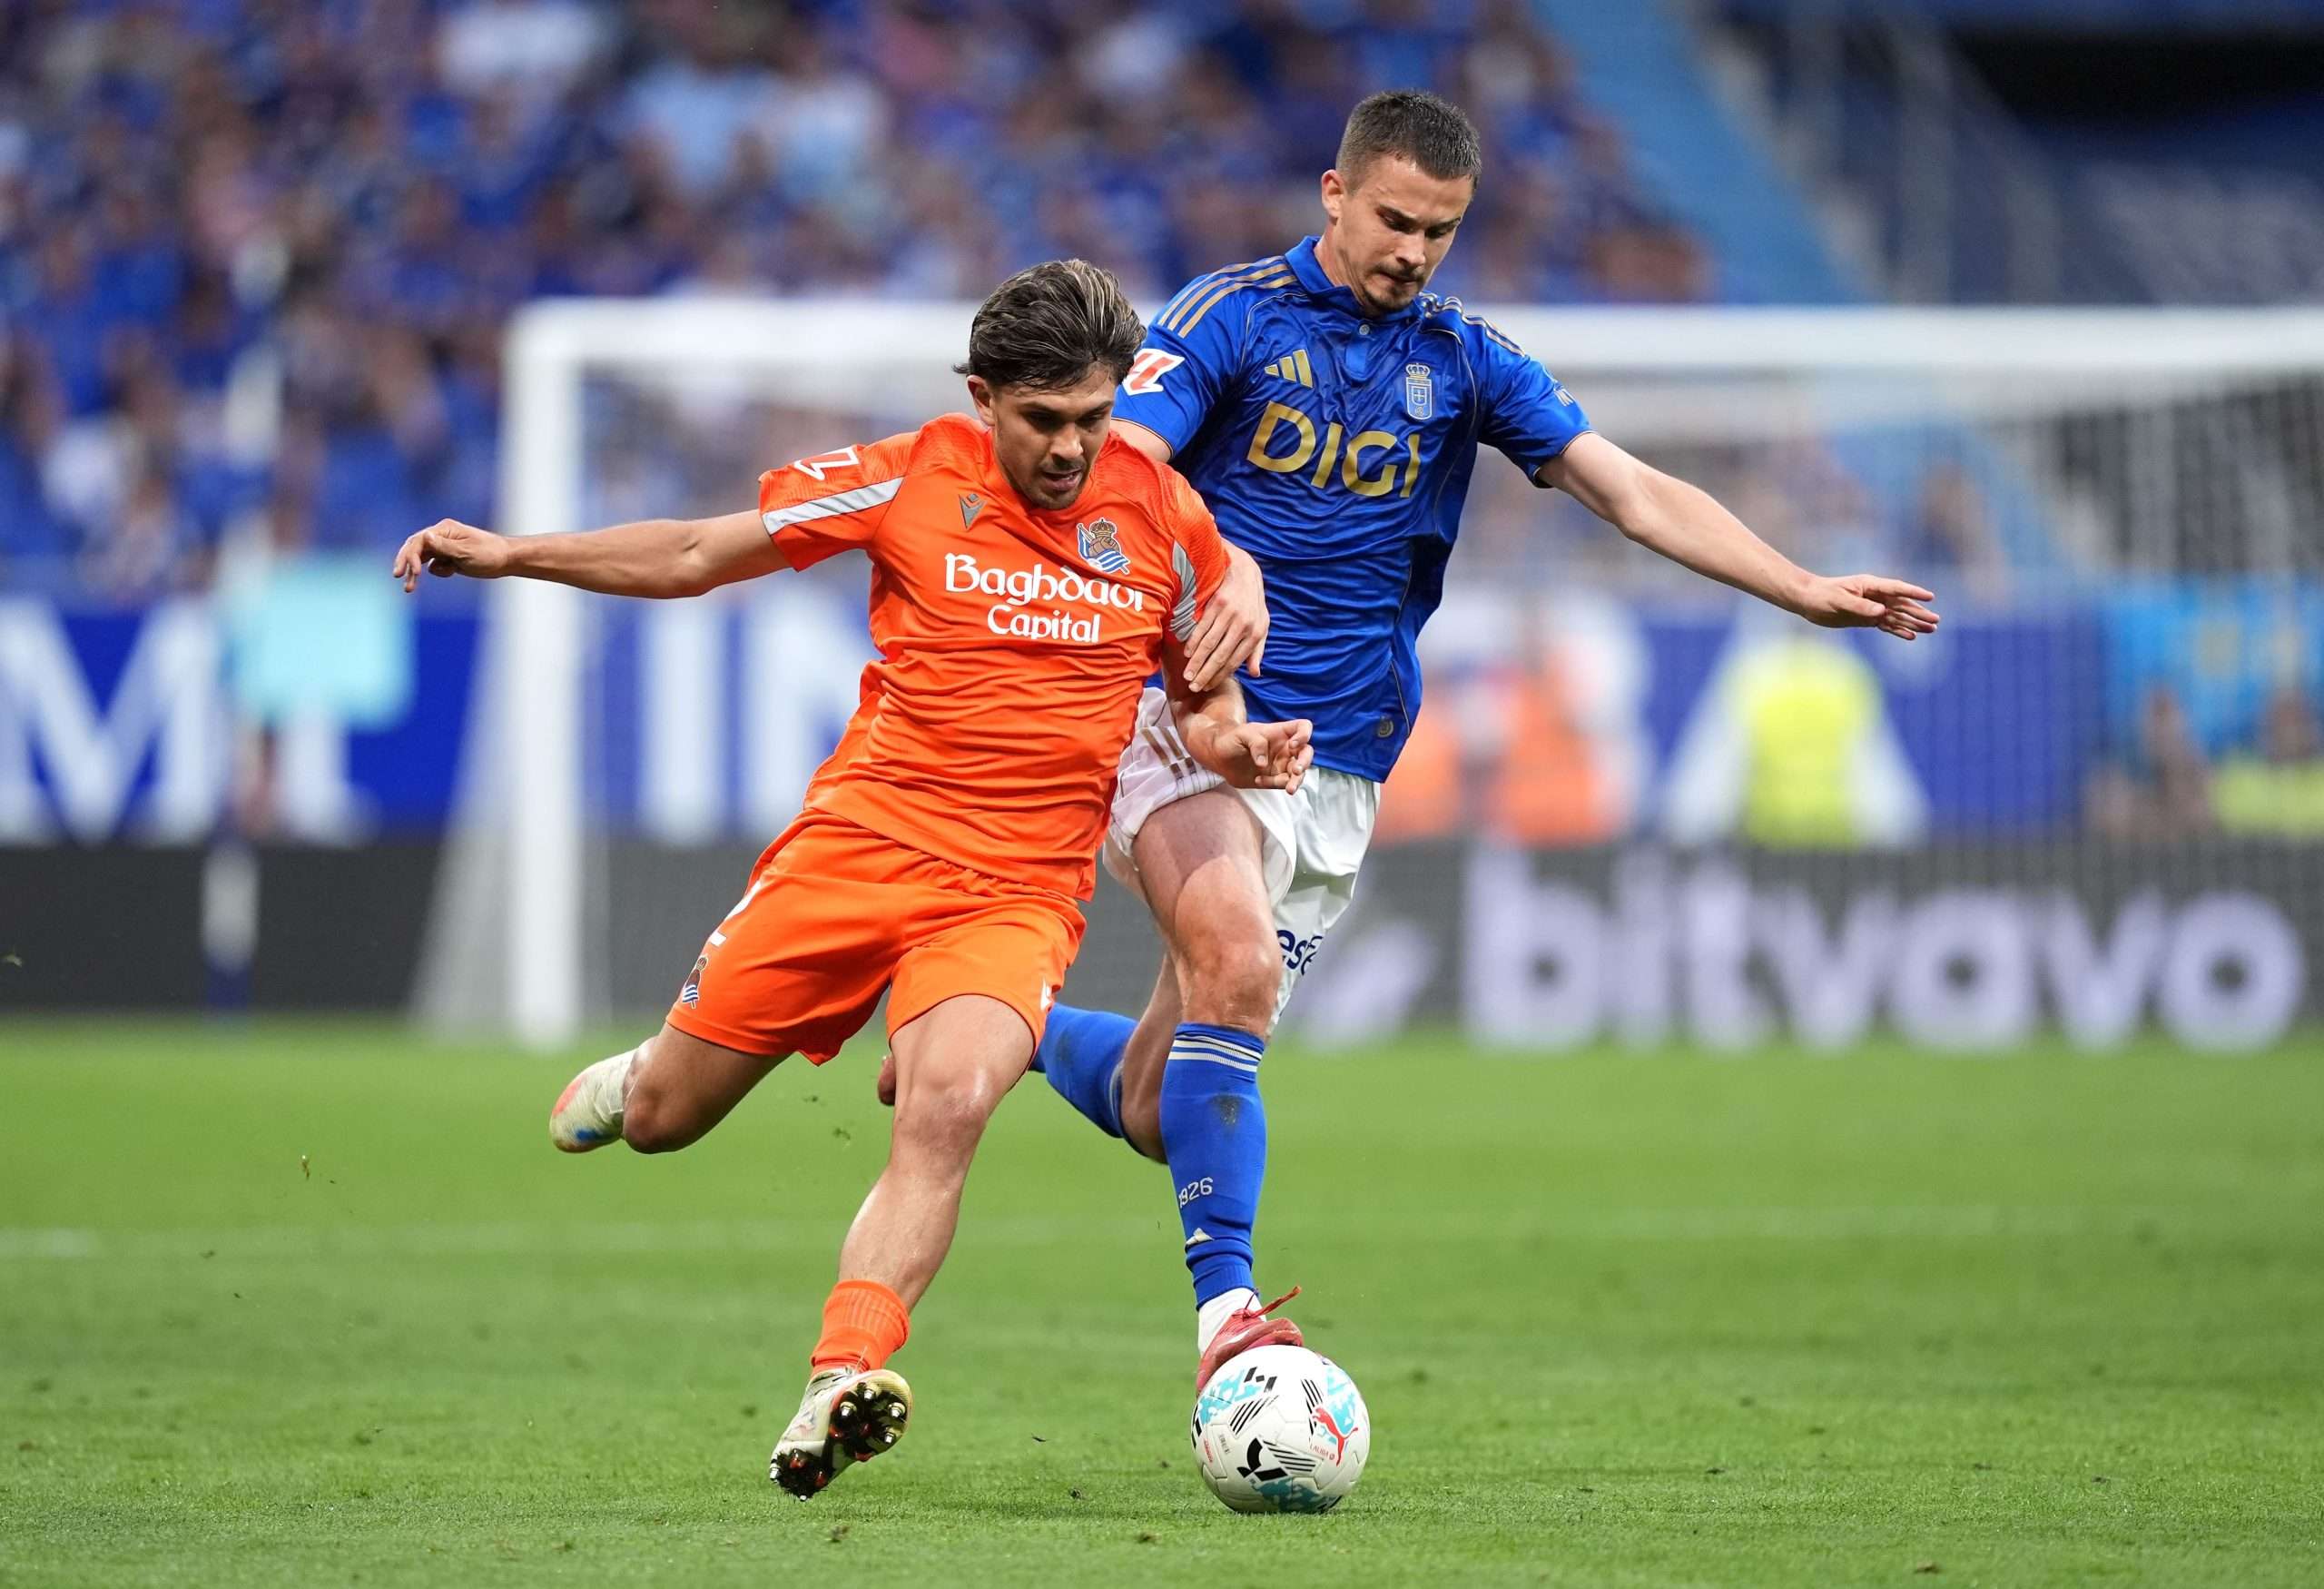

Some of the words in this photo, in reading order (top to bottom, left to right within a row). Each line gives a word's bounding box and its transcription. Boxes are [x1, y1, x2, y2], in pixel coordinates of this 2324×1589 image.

[1246, 400, 1421, 498] DIGI
[987, 604, 1101, 643] Capital
[1463, 843, 2306, 1055] bitvavo
